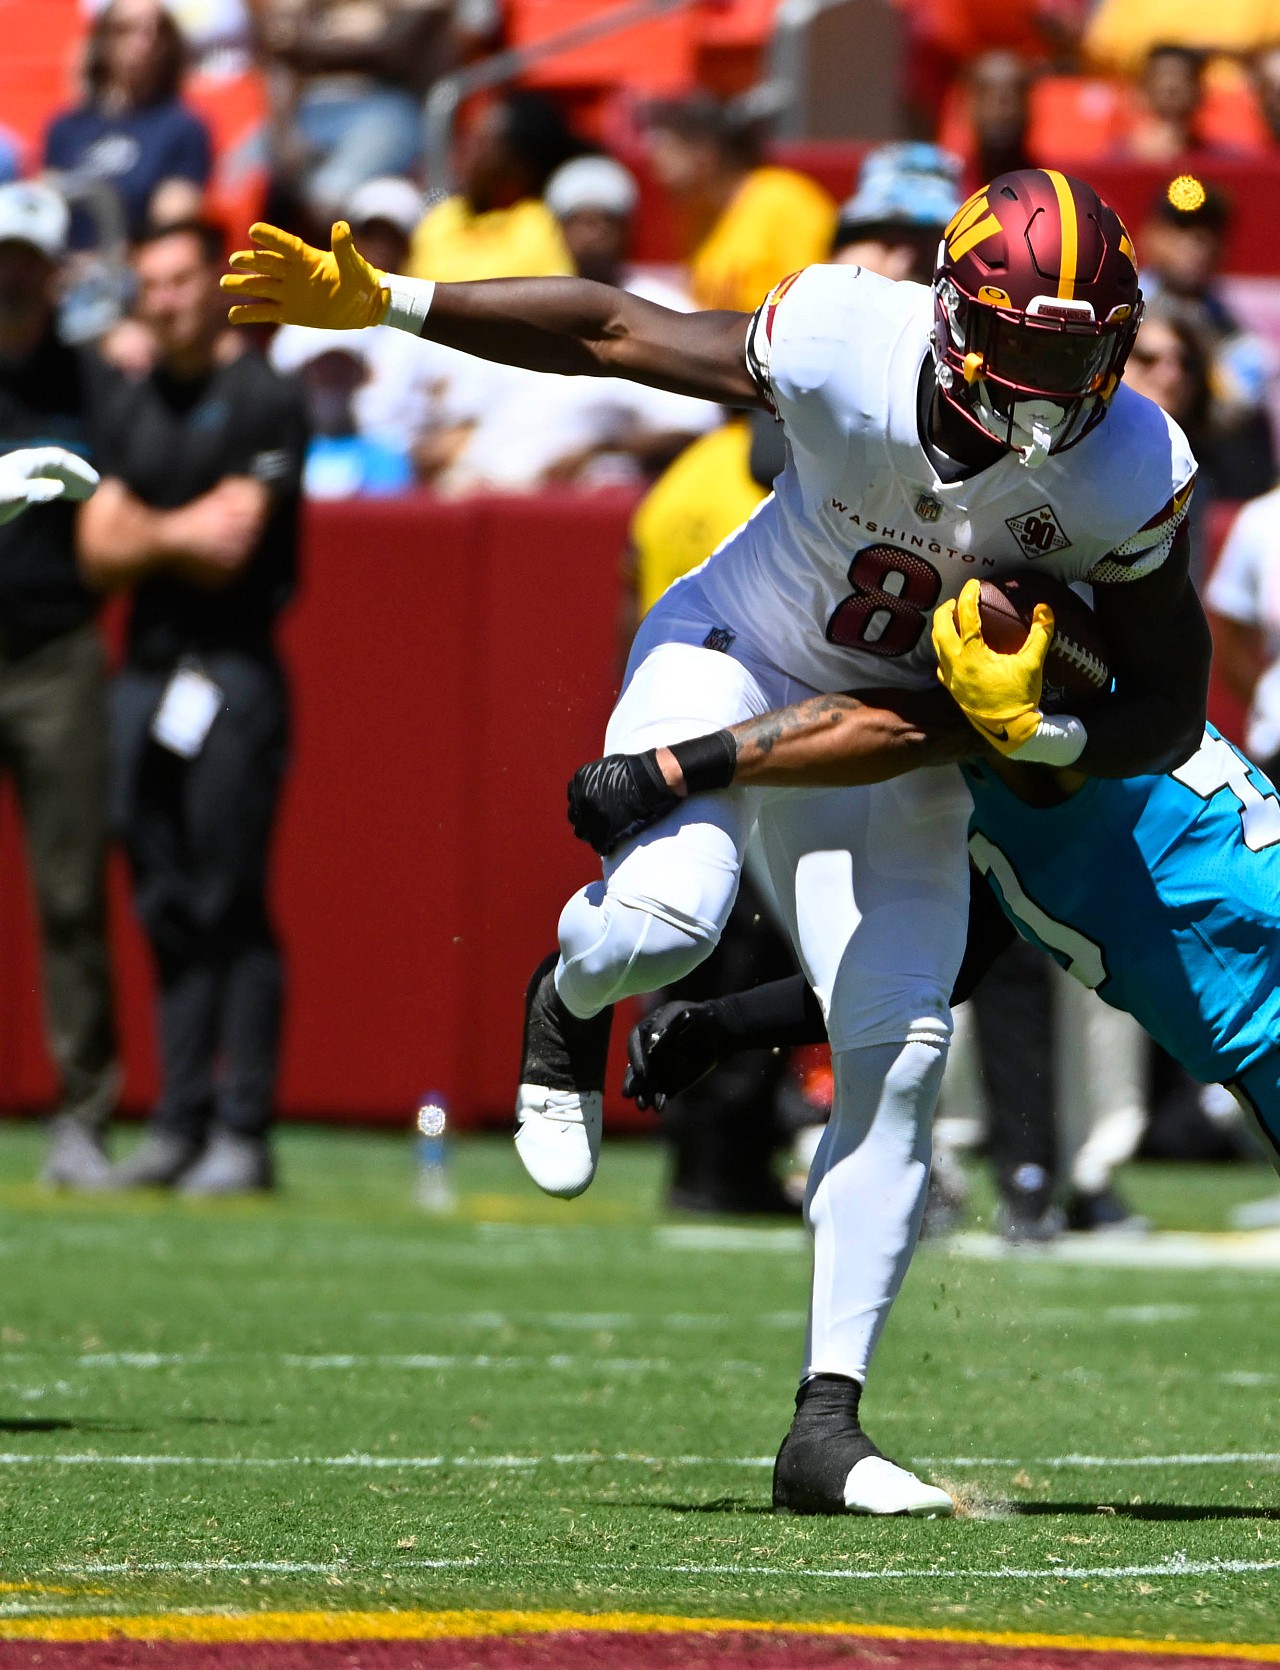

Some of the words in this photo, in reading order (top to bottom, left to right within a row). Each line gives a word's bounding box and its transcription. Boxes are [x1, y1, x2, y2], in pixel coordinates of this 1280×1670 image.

[832, 498, 995, 567] WASHINGTON
[1020, 516, 1056, 550] 90
[826, 543, 942, 657] 8
